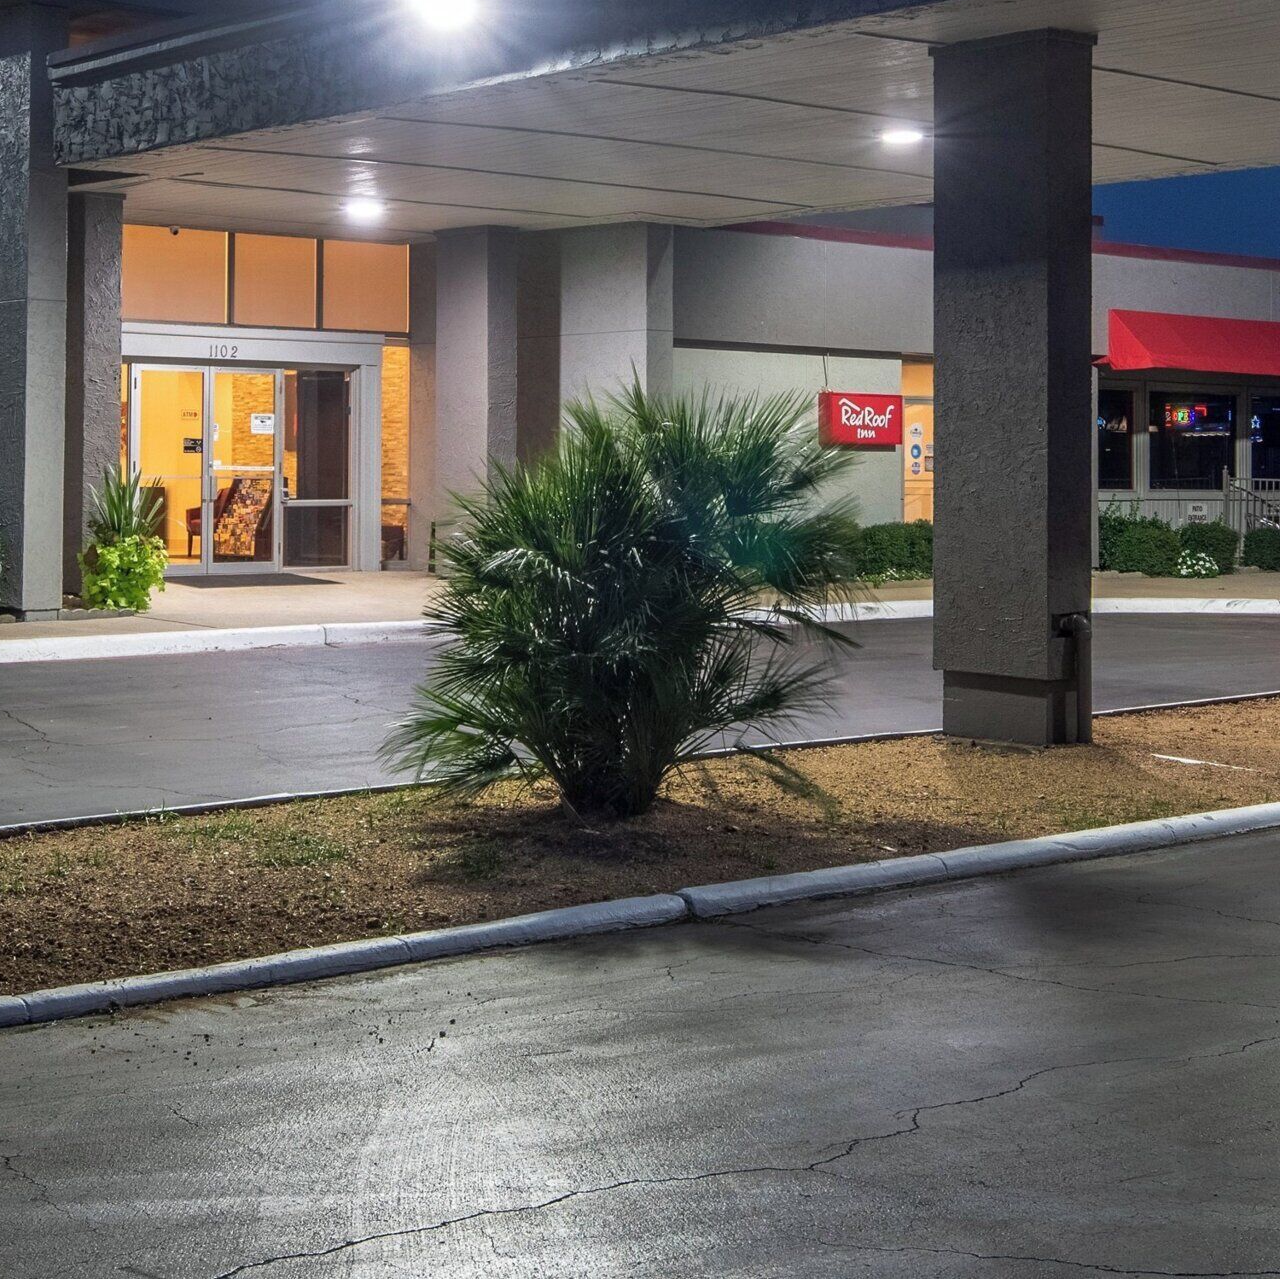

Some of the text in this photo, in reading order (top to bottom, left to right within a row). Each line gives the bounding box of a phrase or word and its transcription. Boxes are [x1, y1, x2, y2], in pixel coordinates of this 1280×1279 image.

[209, 344, 238, 358] 1102
[841, 404, 895, 428] Red Roof
